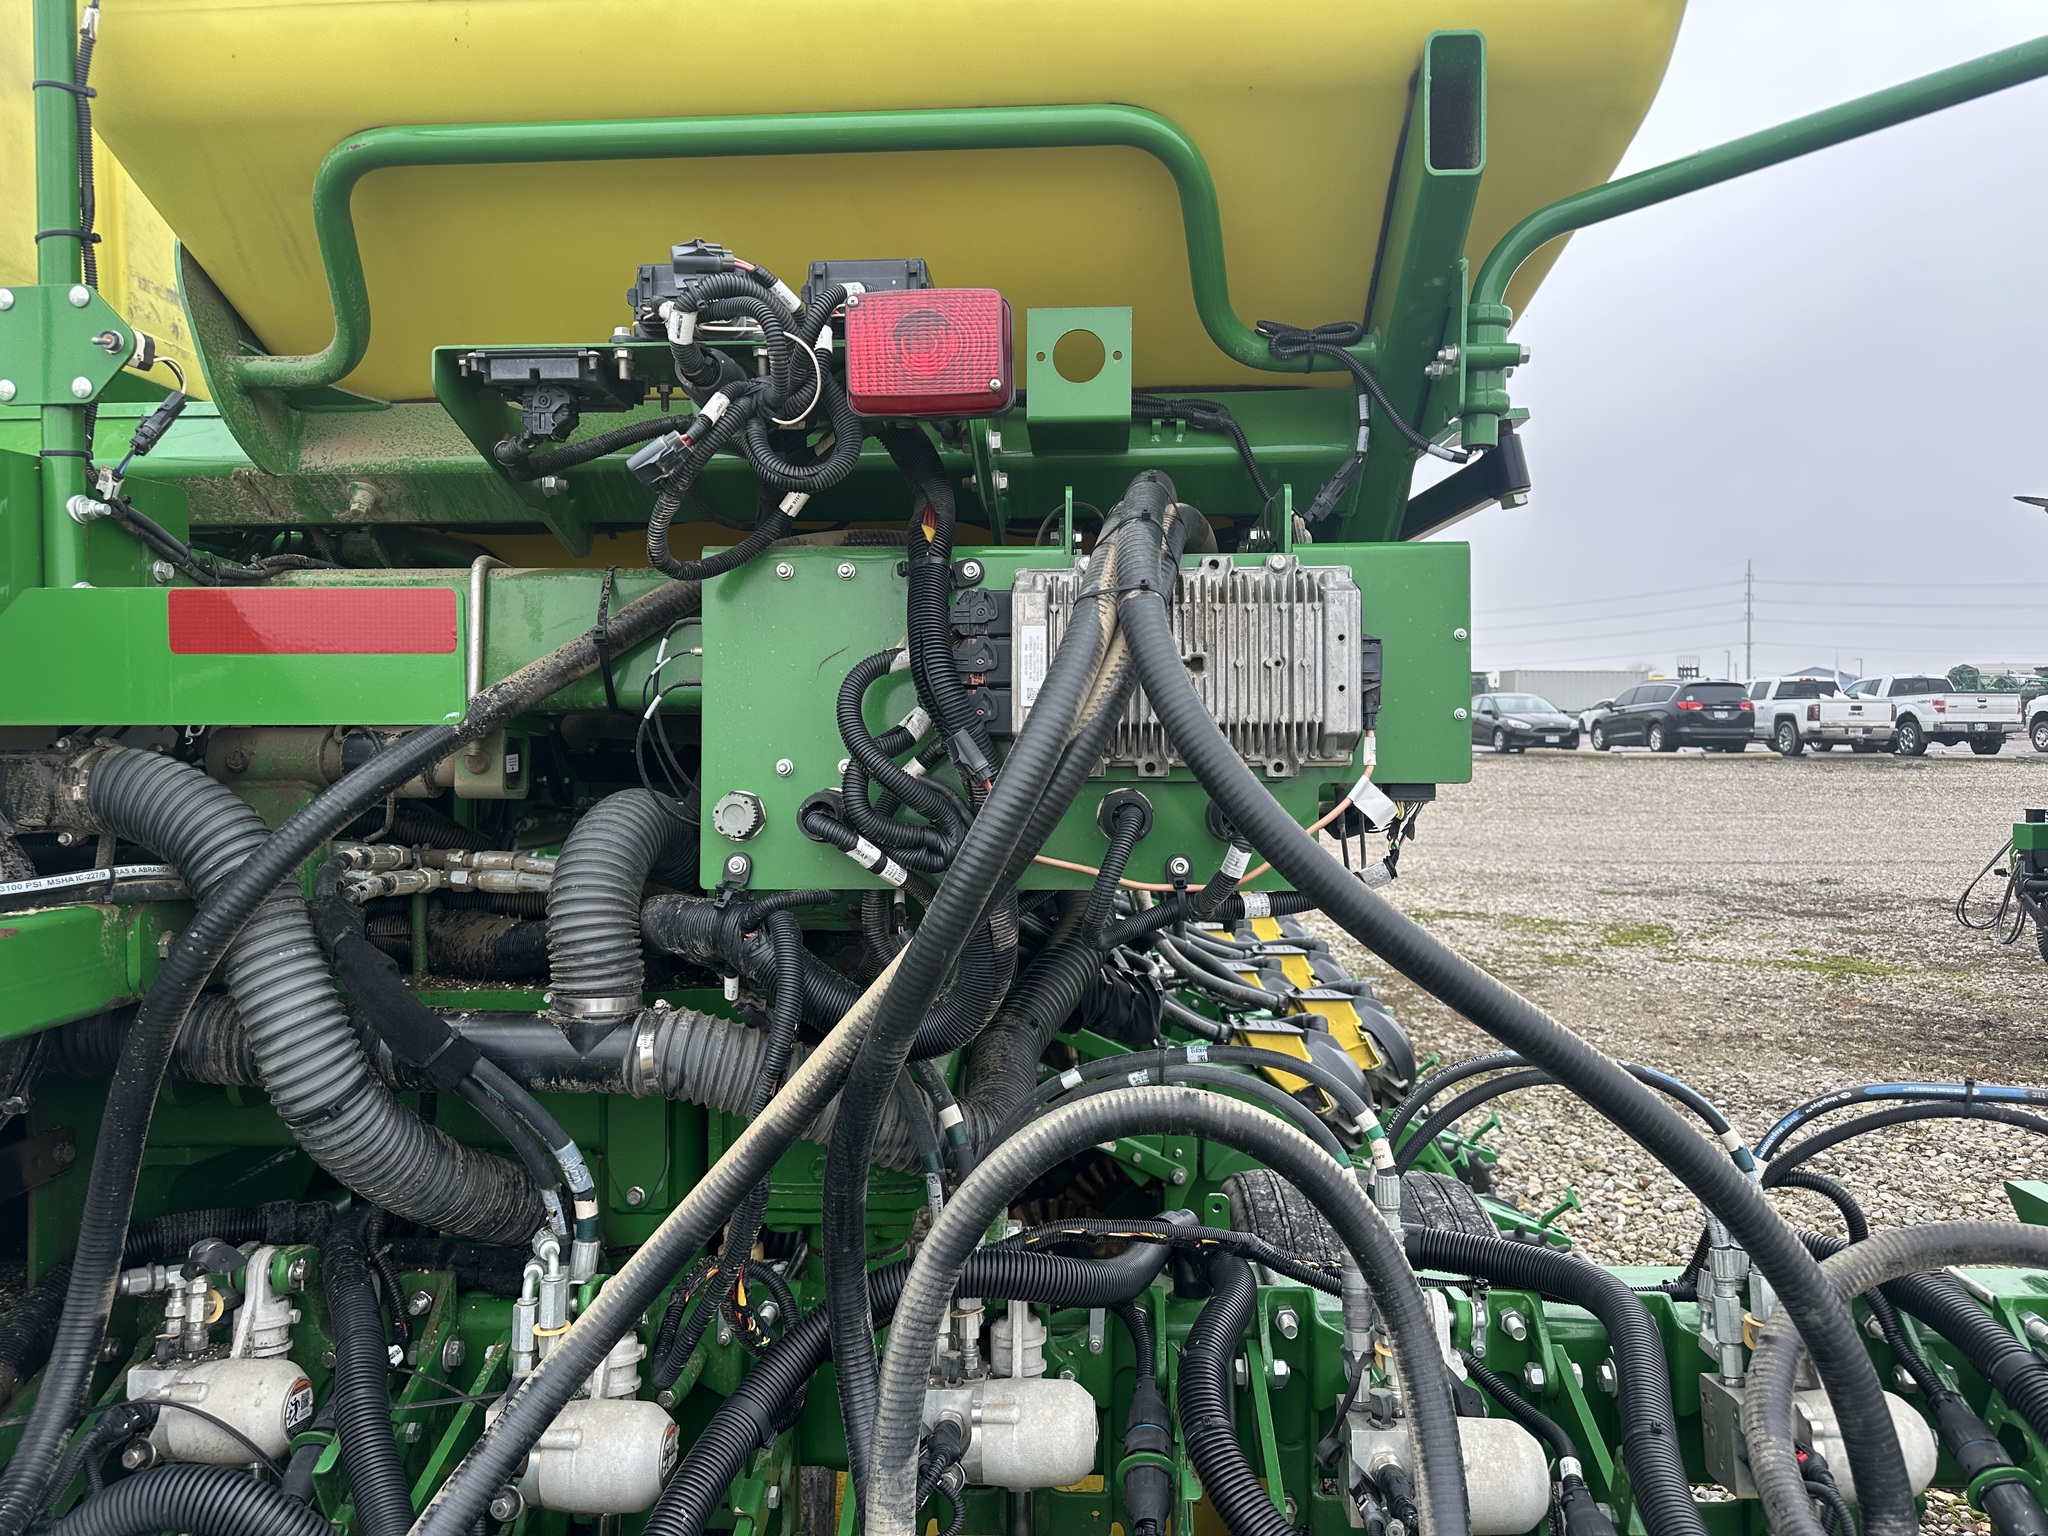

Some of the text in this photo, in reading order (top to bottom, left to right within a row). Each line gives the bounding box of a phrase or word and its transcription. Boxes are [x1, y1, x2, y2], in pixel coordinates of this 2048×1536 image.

[25, 881, 42, 889] PSI
[46, 876, 75, 886] MSHA
[1402, 1096, 1413, 1106] ISO
[1390, 1105, 1405, 1124] 11237
